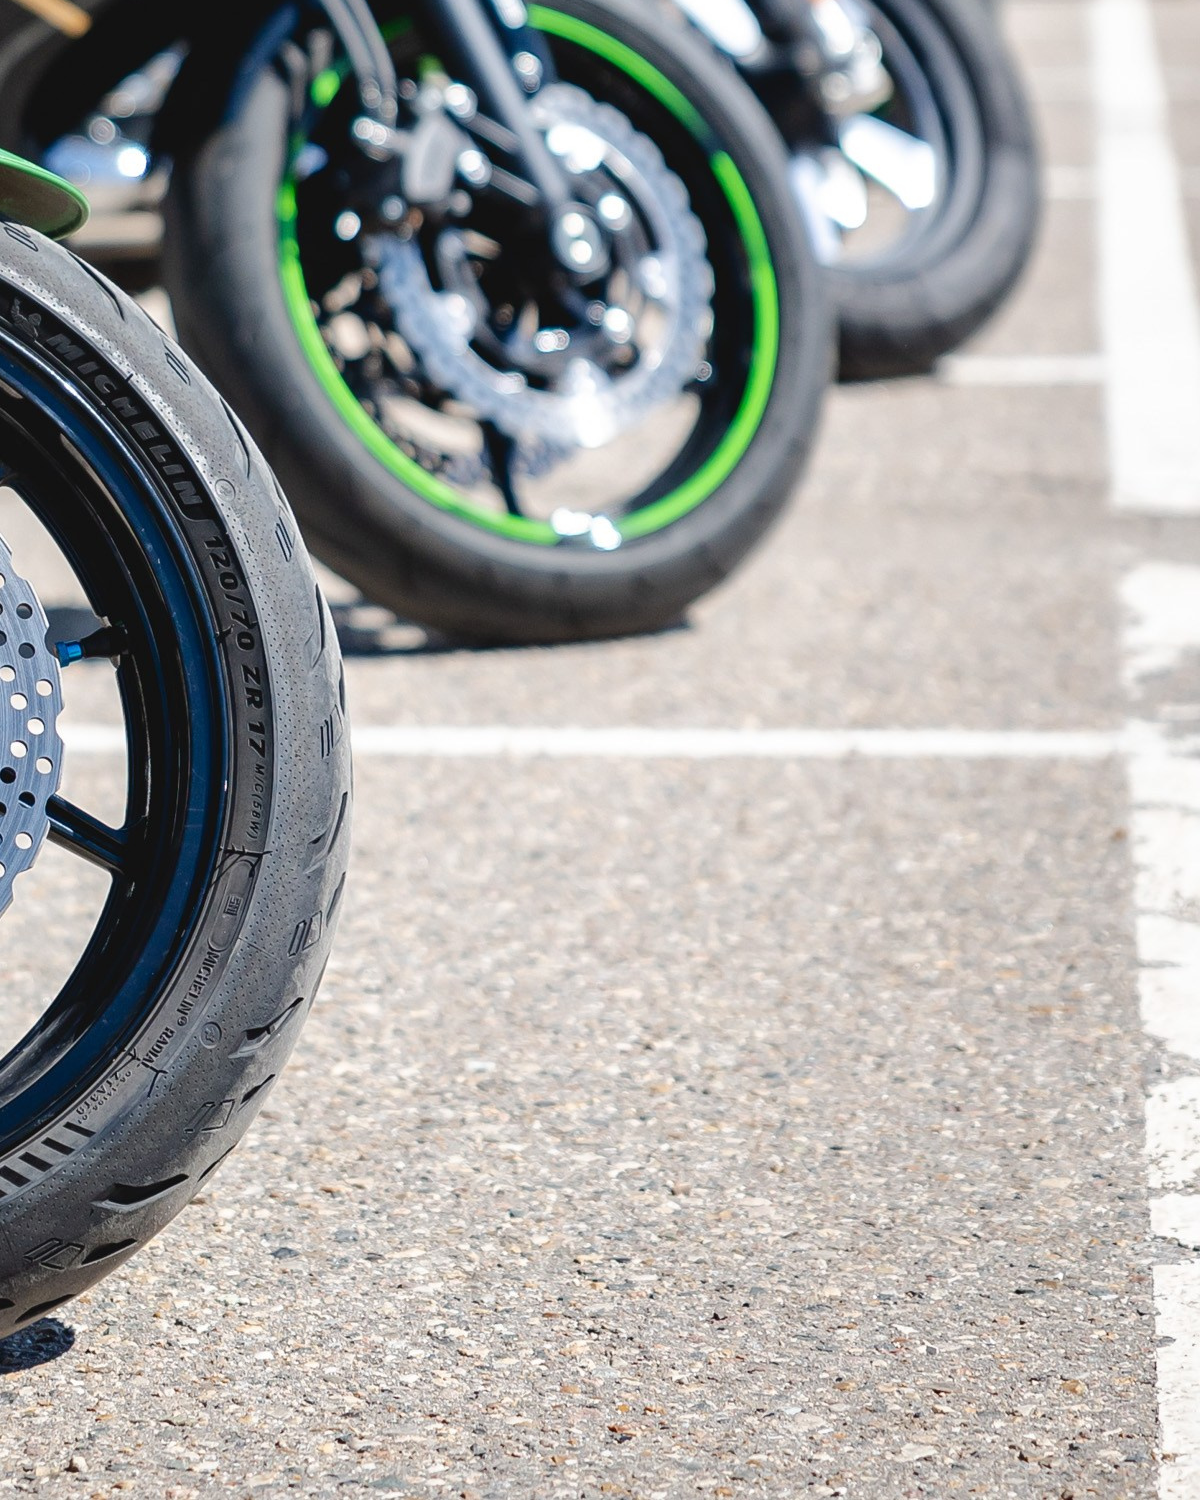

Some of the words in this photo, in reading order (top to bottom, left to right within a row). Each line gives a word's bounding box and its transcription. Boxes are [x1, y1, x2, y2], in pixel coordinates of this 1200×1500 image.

[46, 334, 203, 508] MICHELIN
[204, 535, 255, 651] 120/70
[241, 664, 264, 709] ZR
[248, 721, 266, 759] 17
